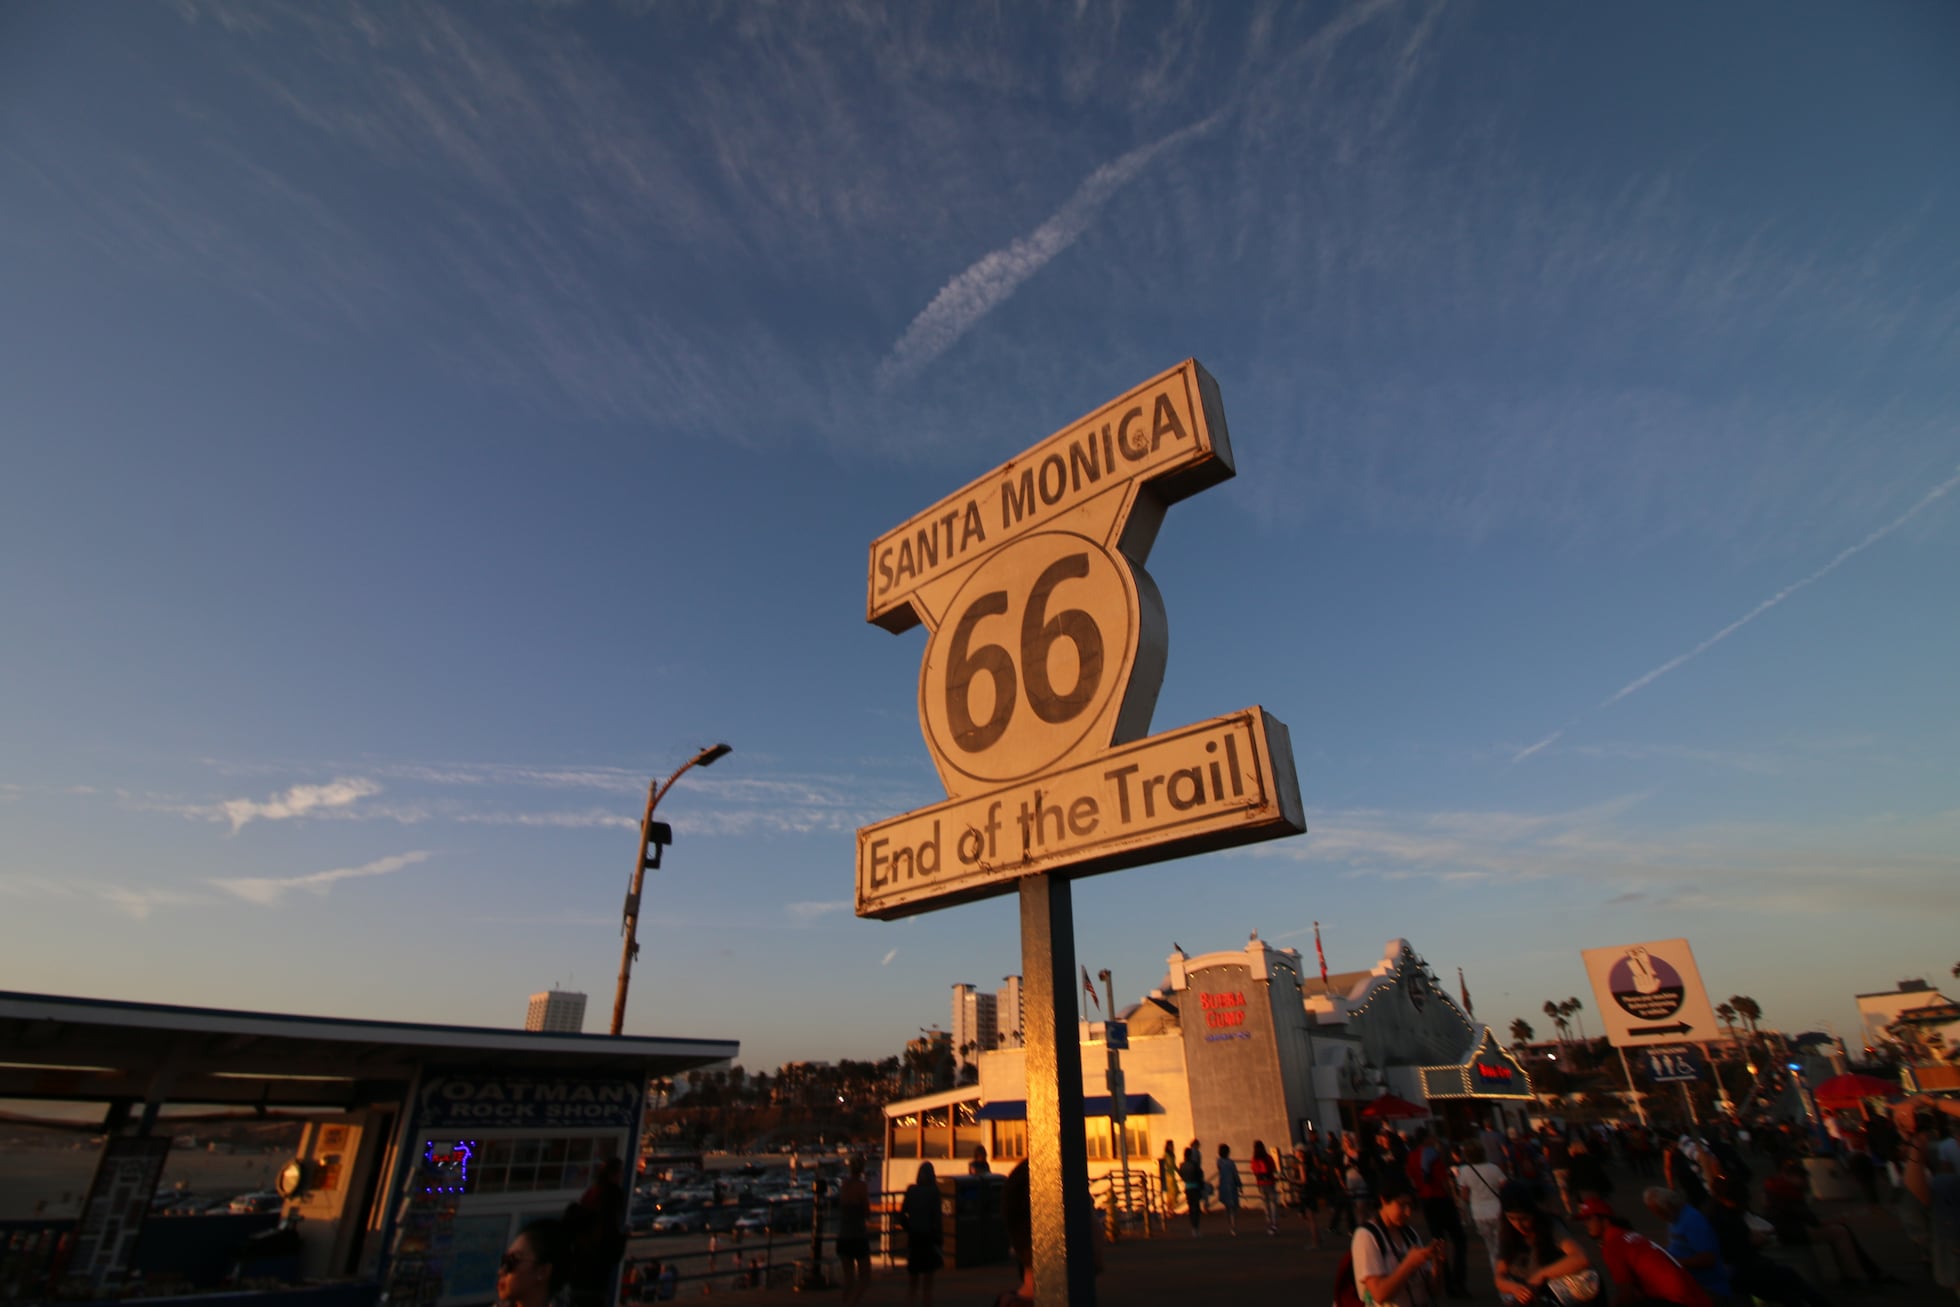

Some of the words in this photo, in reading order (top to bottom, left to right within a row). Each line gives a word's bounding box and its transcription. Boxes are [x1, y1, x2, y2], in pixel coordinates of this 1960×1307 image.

[877, 500, 986, 597] SANTA
[1001, 392, 1187, 530] MONICA
[945, 552, 1105, 753] 66
[869, 820, 942, 889] End
[957, 803, 1001, 865] of
[1017, 791, 1099, 849] the
[1104, 733, 1244, 824] Trail
[442, 1082, 625, 1102] OATMAN
[450, 1103, 536, 1117] ROCK
[544, 1103, 620, 1117] SHOP
